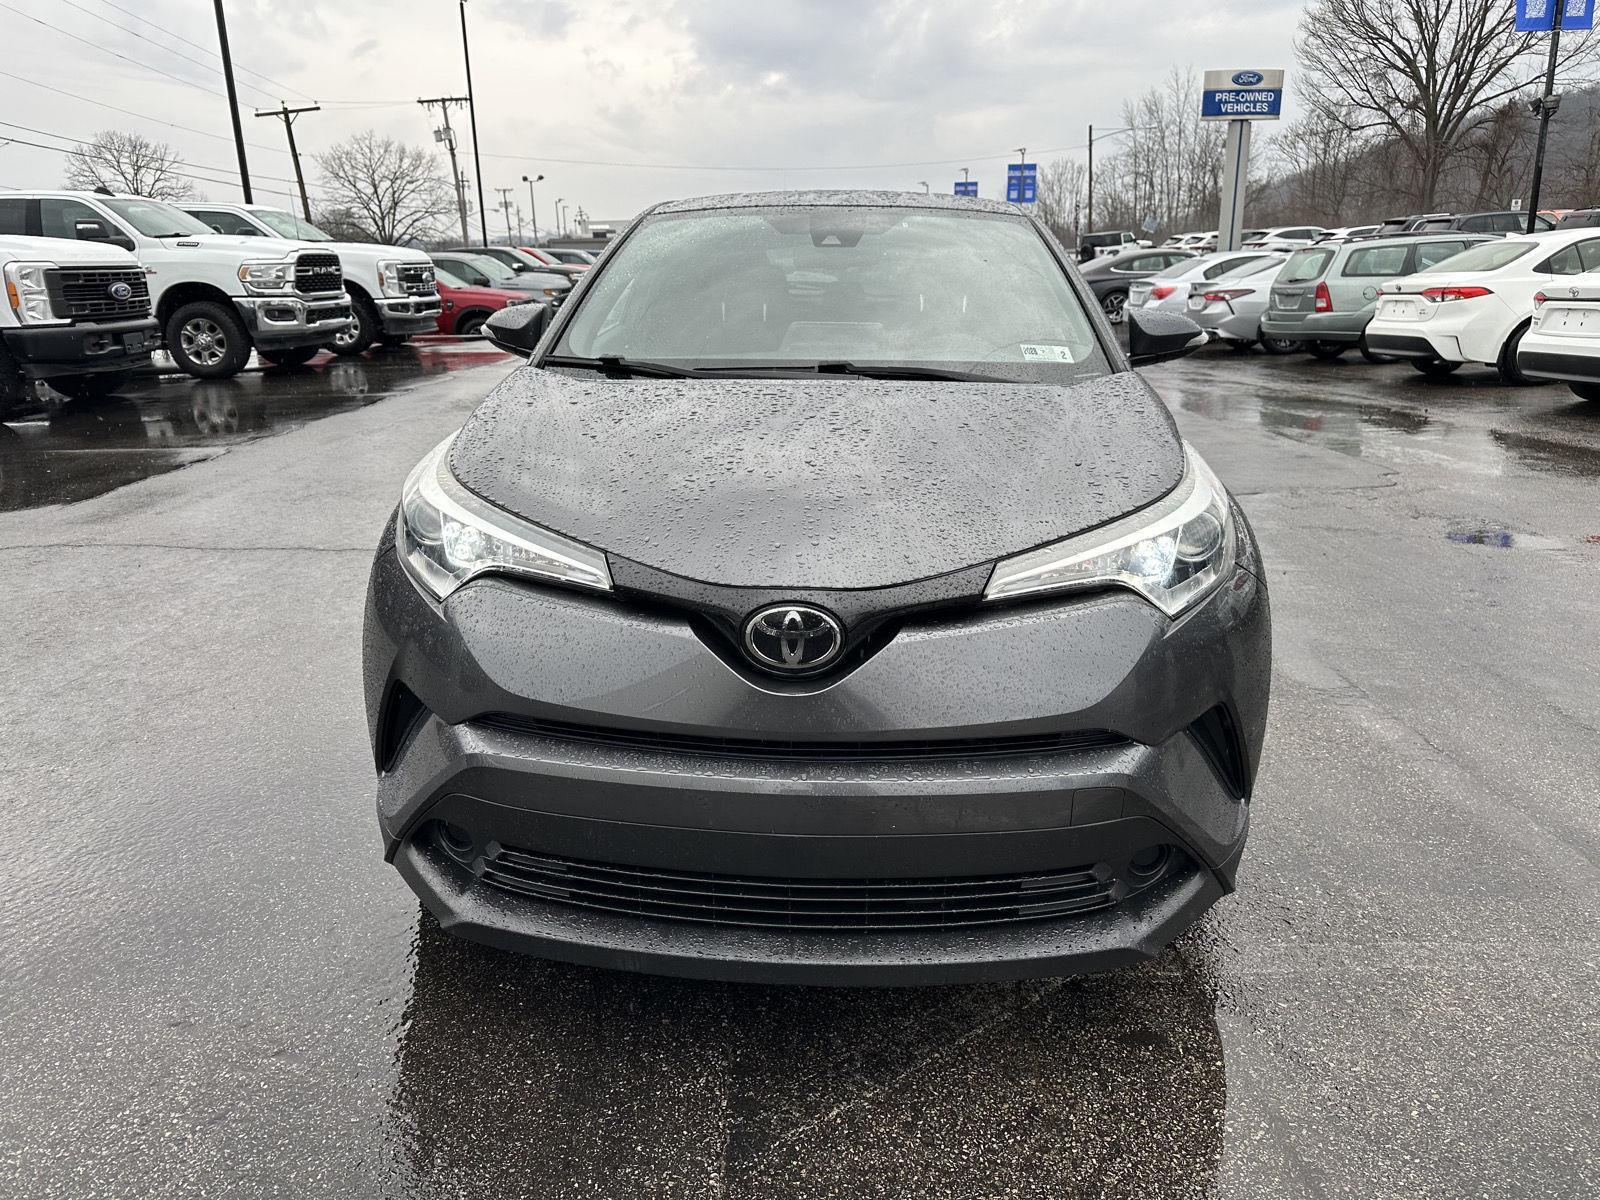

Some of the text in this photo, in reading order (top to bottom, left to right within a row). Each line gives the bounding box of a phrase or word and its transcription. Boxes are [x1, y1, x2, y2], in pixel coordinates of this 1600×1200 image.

[1239, 74, 1259, 83] Ford
[1215, 92, 1275, 102] PRE-OWNED
[1220, 103, 1269, 113] VEHICLES
[313, 266, 335, 274] RAM
[1060, 350, 1067, 360] 2
